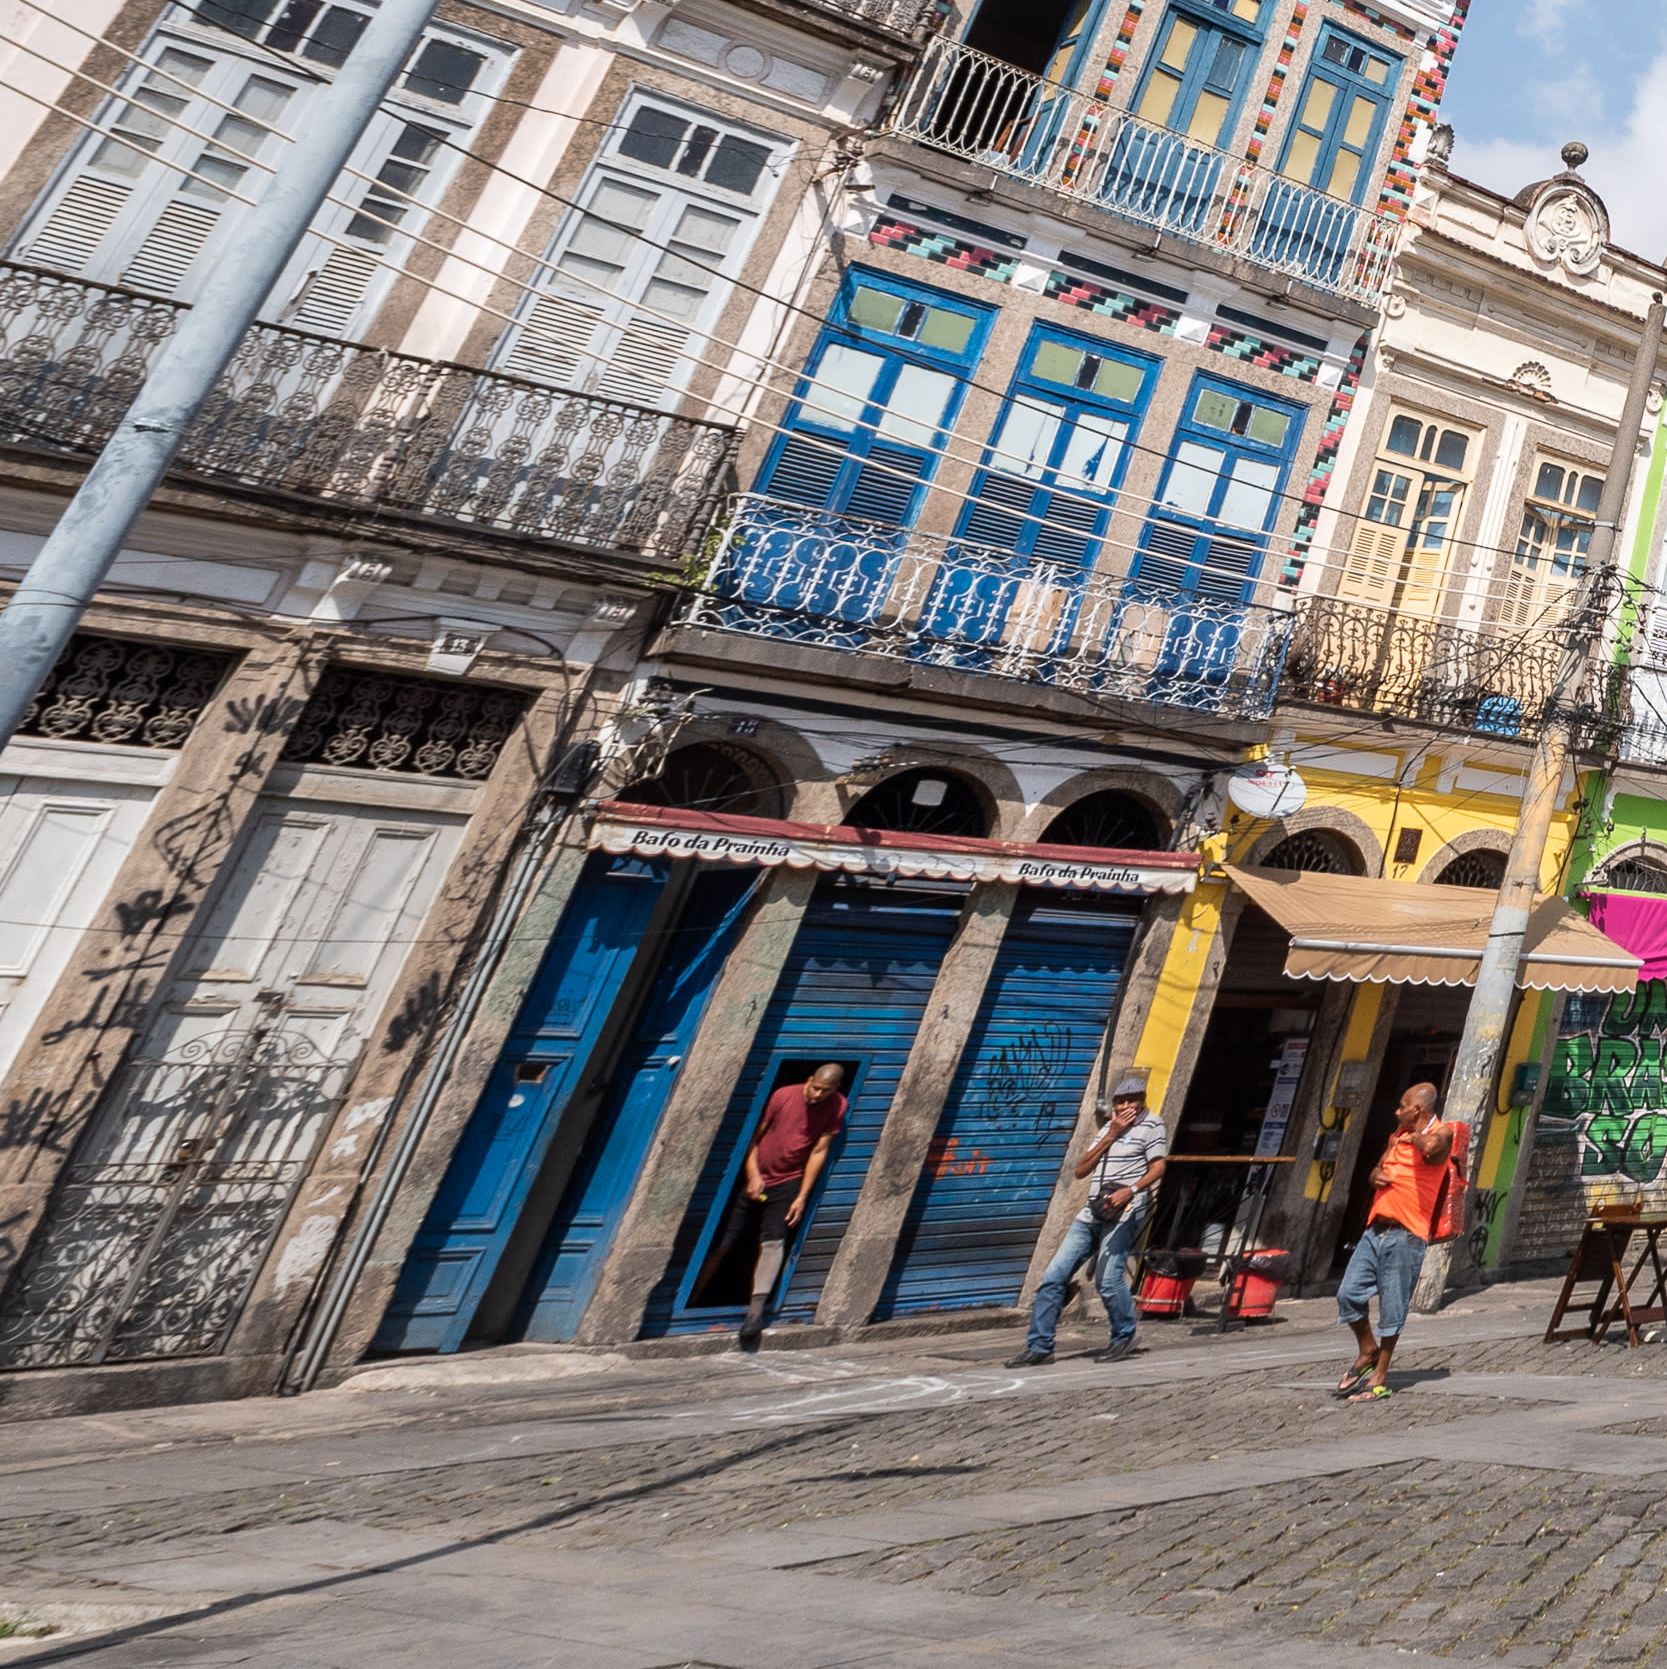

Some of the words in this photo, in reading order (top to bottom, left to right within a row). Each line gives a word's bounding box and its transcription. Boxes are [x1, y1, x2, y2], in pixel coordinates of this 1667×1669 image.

[631, 830, 681, 848] Bafo
[684, 835, 708, 850] da
[712, 837, 790, 857] Prainha
[1018, 862, 1055, 877] Bafo
[1058, 865, 1077, 879] da
[1080, 867, 1139, 882] Prainha
[1392, 864, 1408, 879] 17
